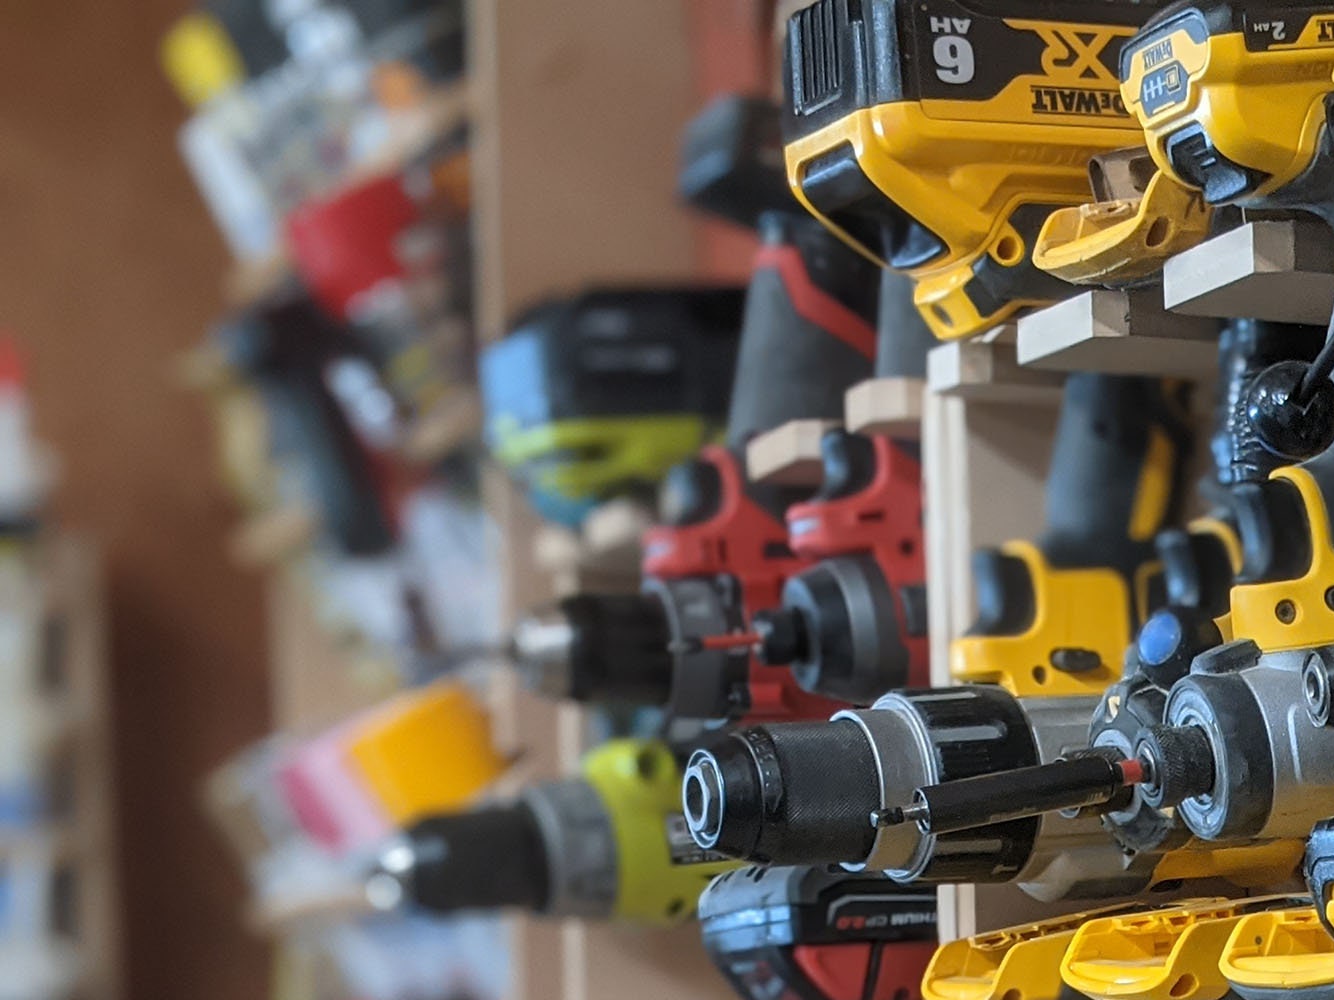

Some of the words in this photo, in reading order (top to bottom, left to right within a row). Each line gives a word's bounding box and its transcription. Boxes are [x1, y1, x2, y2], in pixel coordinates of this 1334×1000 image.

[930, 16, 971, 34] AH
[933, 36, 975, 84] 6
[1024, 20, 1129, 80] XR
[1143, 39, 1174, 67] DEWALT
